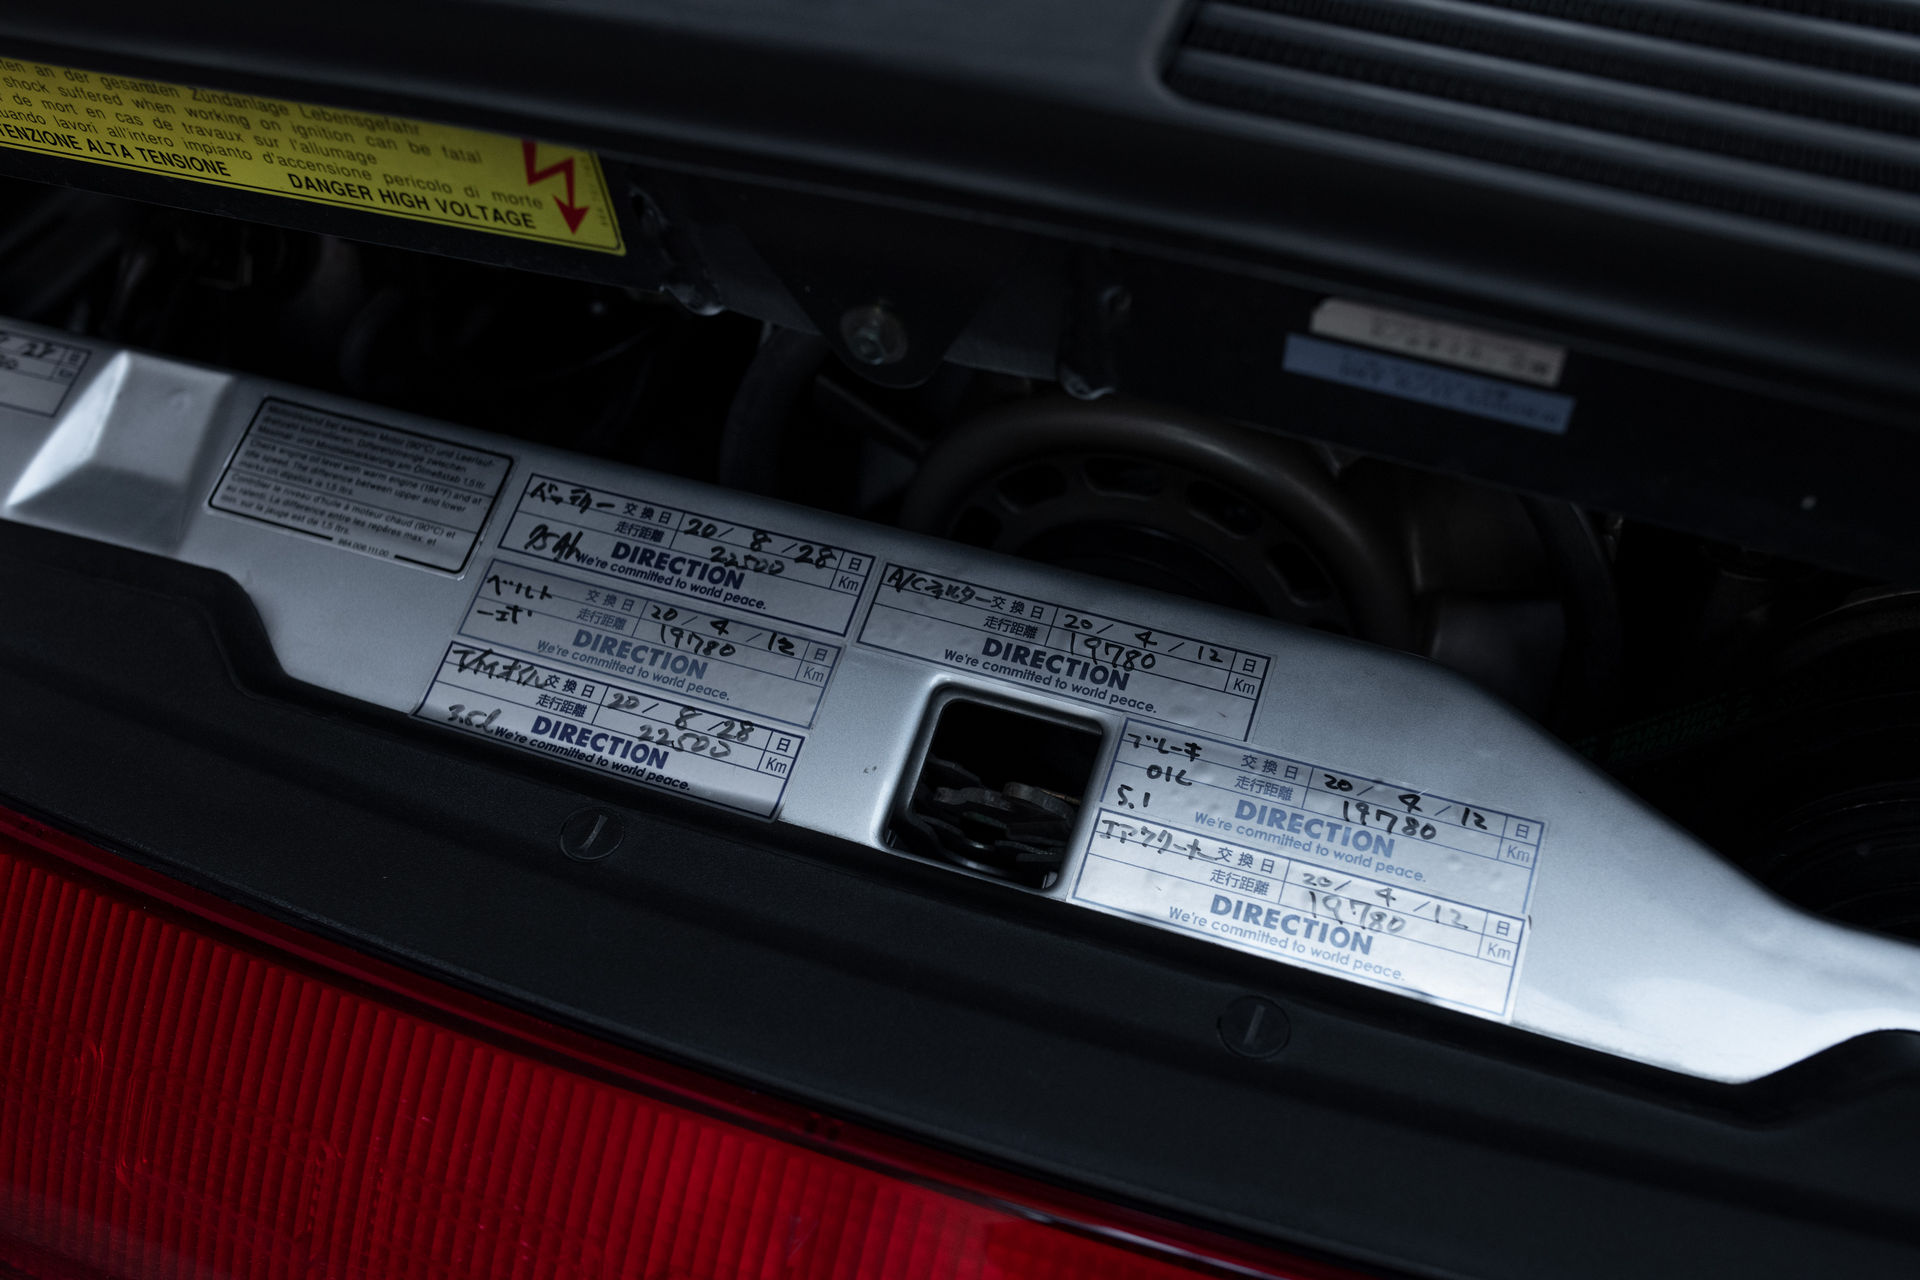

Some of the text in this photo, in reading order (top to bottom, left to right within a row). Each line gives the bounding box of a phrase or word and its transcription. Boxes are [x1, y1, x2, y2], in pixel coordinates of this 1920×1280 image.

[34, 66, 56, 78] an
[64, 69, 89, 83] der
[100, 77, 180, 98] gesamten
[299, 107, 419, 134] Lebensgefahr
[3, 76, 482, 163] shock suffered when working on ignition can be fatal
[12, 93, 377, 166] de mort en cas de travaux sur l'allumage
[0, 110, 542, 209] uando lavori all'intero impianto d'accensione pericolo di morte
[87, 139, 134, 159] ALTA
[136, 147, 230, 176] TENSIONE
[288, 174, 536, 228] DANGER HIGH VOLTAGE
[624, 503, 671, 524] 交換日
[615, 521, 664, 542] 走行距離
[612, 542, 744, 589] DIRECTION
[708, 546, 784, 577] 22500
[848, 557, 862, 571] 日
[577, 552, 766, 609] We're committed to world peace.
[838, 576, 859, 591] Km
[586, 590, 635, 612] 交換日
[991, 596, 1044, 619] 交換日
[577, 609, 627, 630] 走行距離
[984, 616, 1038, 639] 走行距離
[574, 630, 707, 678] DIRECTION
[983, 639, 1129, 690] DIRECTION
[1066, 632, 1156, 674] 19780
[1242, 658, 1256, 673] 日
[538, 640, 730, 700] We're committed to world peace.
[803, 666, 824, 682] Km
[945, 649, 1157, 713] We're committed to world peace.
[544, 675, 595, 698] 交換日
[1233, 678, 1255, 694] Km
[536, 694, 587, 717] 走行距離
[532, 717, 668, 768] DIRECTION
[636, 726, 730, 763] 22500
[776, 737, 791, 752] 日
[1126, 734, 1202, 761] ブレーキ
[491, 727, 690, 790] We're committed to world peace.
[766, 757, 787, 773] Km
[1241, 755, 1298, 779] 交換日
[1235, 776, 1293, 801] 走行距離
[1236, 800, 1394, 856] DIRECTION
[1342, 801, 1436, 839] 19780
[1195, 812, 1426, 882] We're committed to world peace.
[1215, 847, 1274, 873] 交換日
[1507, 845, 1529, 862] Km
[1210, 870, 1269, 895] 走行距離
[1211, 895, 1372, 953] DIRECTION
[1496, 920, 1510, 936] 日
[1170, 906, 1405, 980] We're committed to world peace.
[1487, 942, 1511, 960] Km
